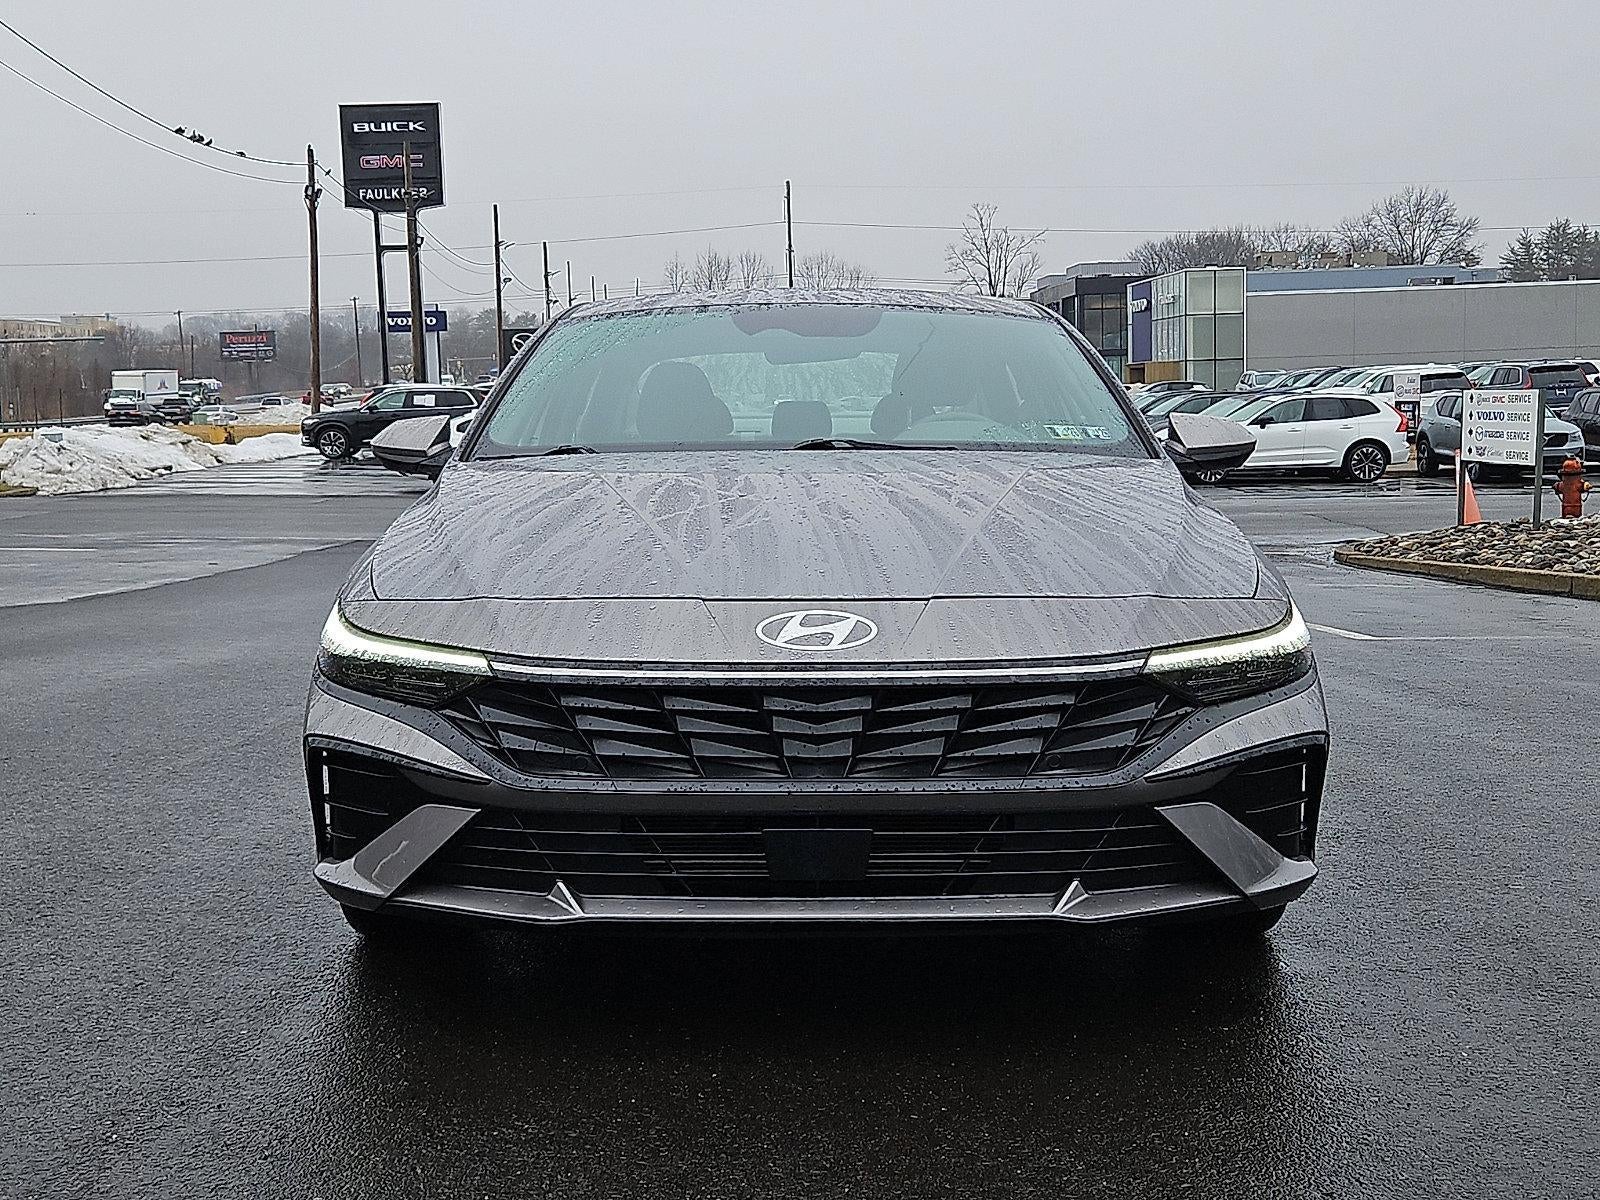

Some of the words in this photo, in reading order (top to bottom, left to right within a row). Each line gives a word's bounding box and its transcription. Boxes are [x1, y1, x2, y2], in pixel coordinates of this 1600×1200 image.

[353, 121, 426, 132] BUICK
[360, 154, 423, 169] GMC
[387, 317, 437, 326] VOLO
[1507, 394, 1532, 404] SERVICE
[1476, 411, 1505, 421] VOLVO
[1506, 412, 1531, 422] SERVICE
[1506, 431, 1530, 441] SERVICE
[1505, 450, 1529, 461] SERVICE
